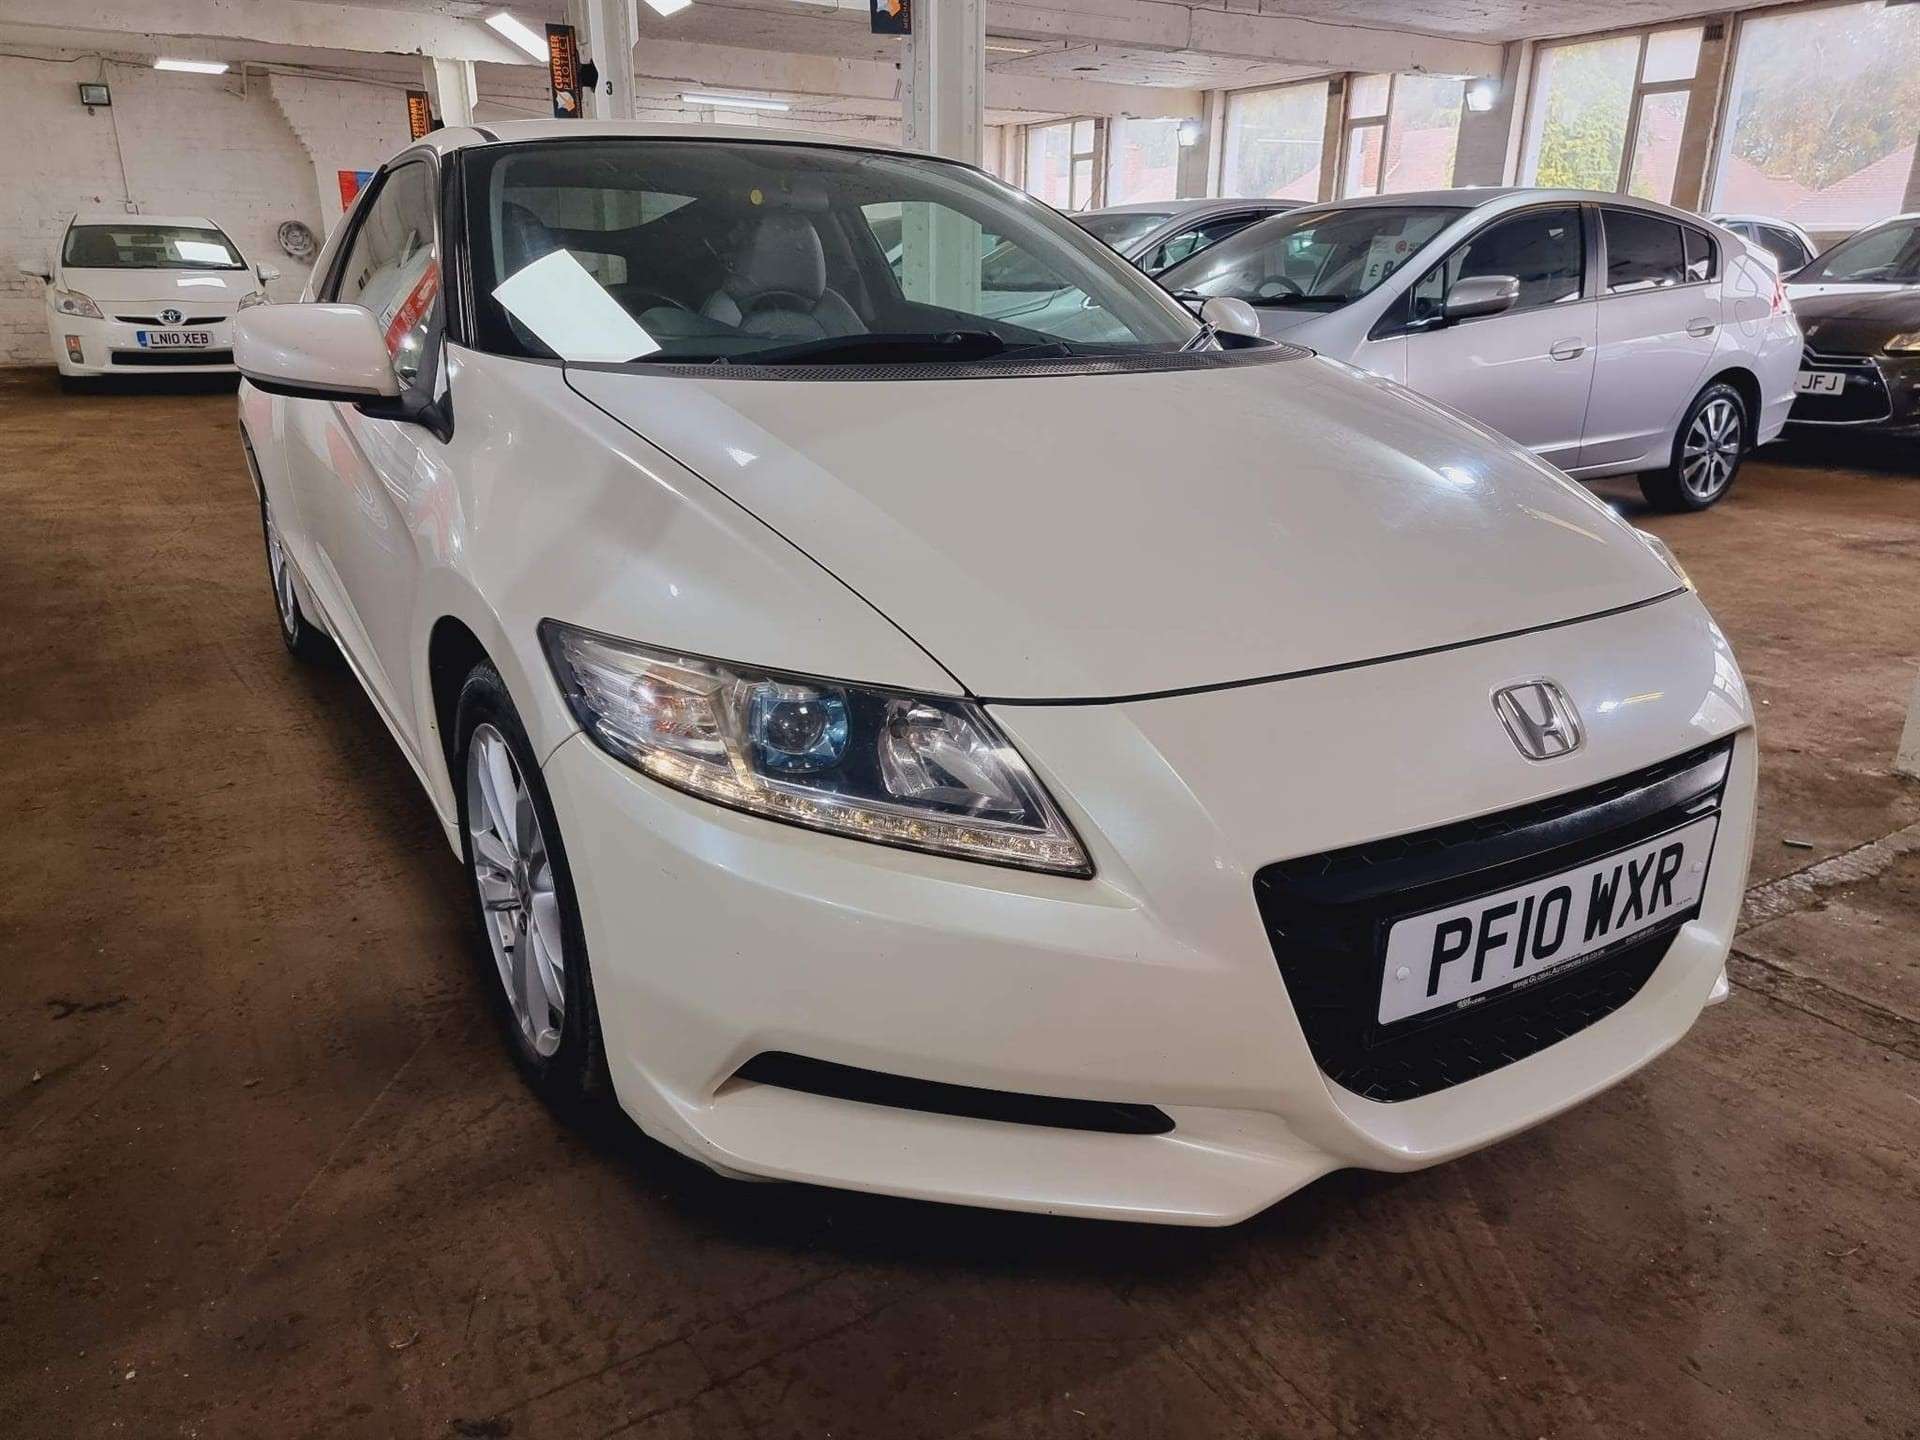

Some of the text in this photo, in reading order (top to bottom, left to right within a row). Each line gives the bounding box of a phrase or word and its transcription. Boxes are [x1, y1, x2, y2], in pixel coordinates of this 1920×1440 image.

[550, 35, 564, 89] CUSTOMER
[559, 36, 572, 90] PROTECT
[605, 80, 613, 96] 3
[150, 333, 209, 345] LN10 XEB
[1802, 375, 1838, 391] JFJ
[1426, 842, 1684, 998] PF10 WXR
